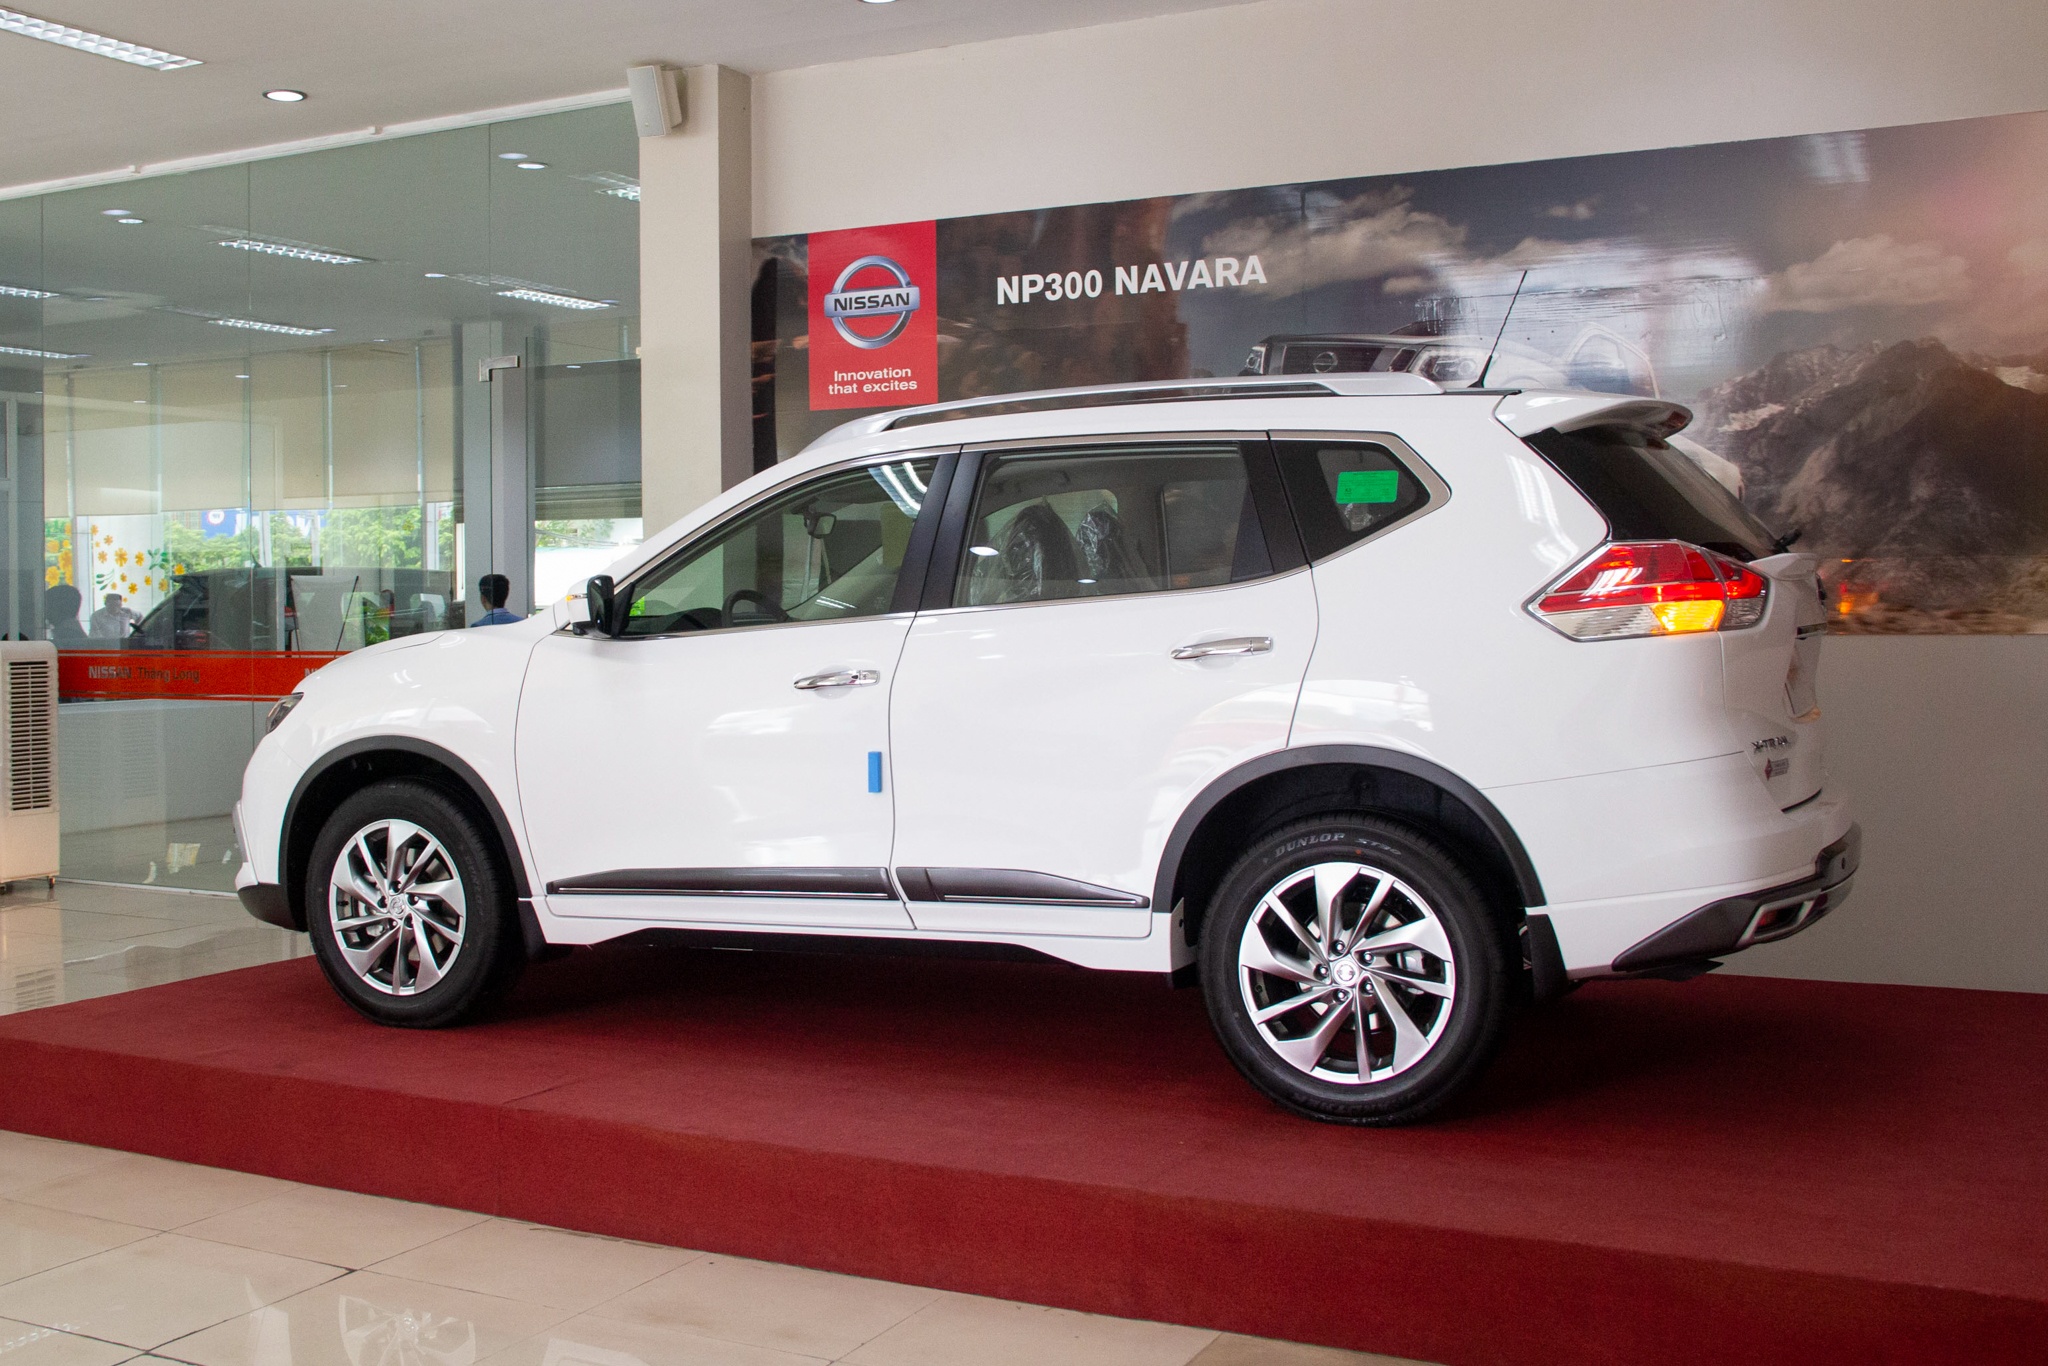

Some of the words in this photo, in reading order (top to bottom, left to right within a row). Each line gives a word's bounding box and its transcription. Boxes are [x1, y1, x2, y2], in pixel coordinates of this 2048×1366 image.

[996, 269, 1103, 305] NP300
[1114, 255, 1268, 295] NAVARA
[833, 291, 911, 312] NISSAN
[834, 367, 912, 382] Innovation
[828, 383, 858, 395] that
[863, 380, 918, 393] excites
[88, 666, 132, 679] NISSAN
[173, 668, 200, 683] Long
[1274, 832, 1346, 857] DUNLOP
